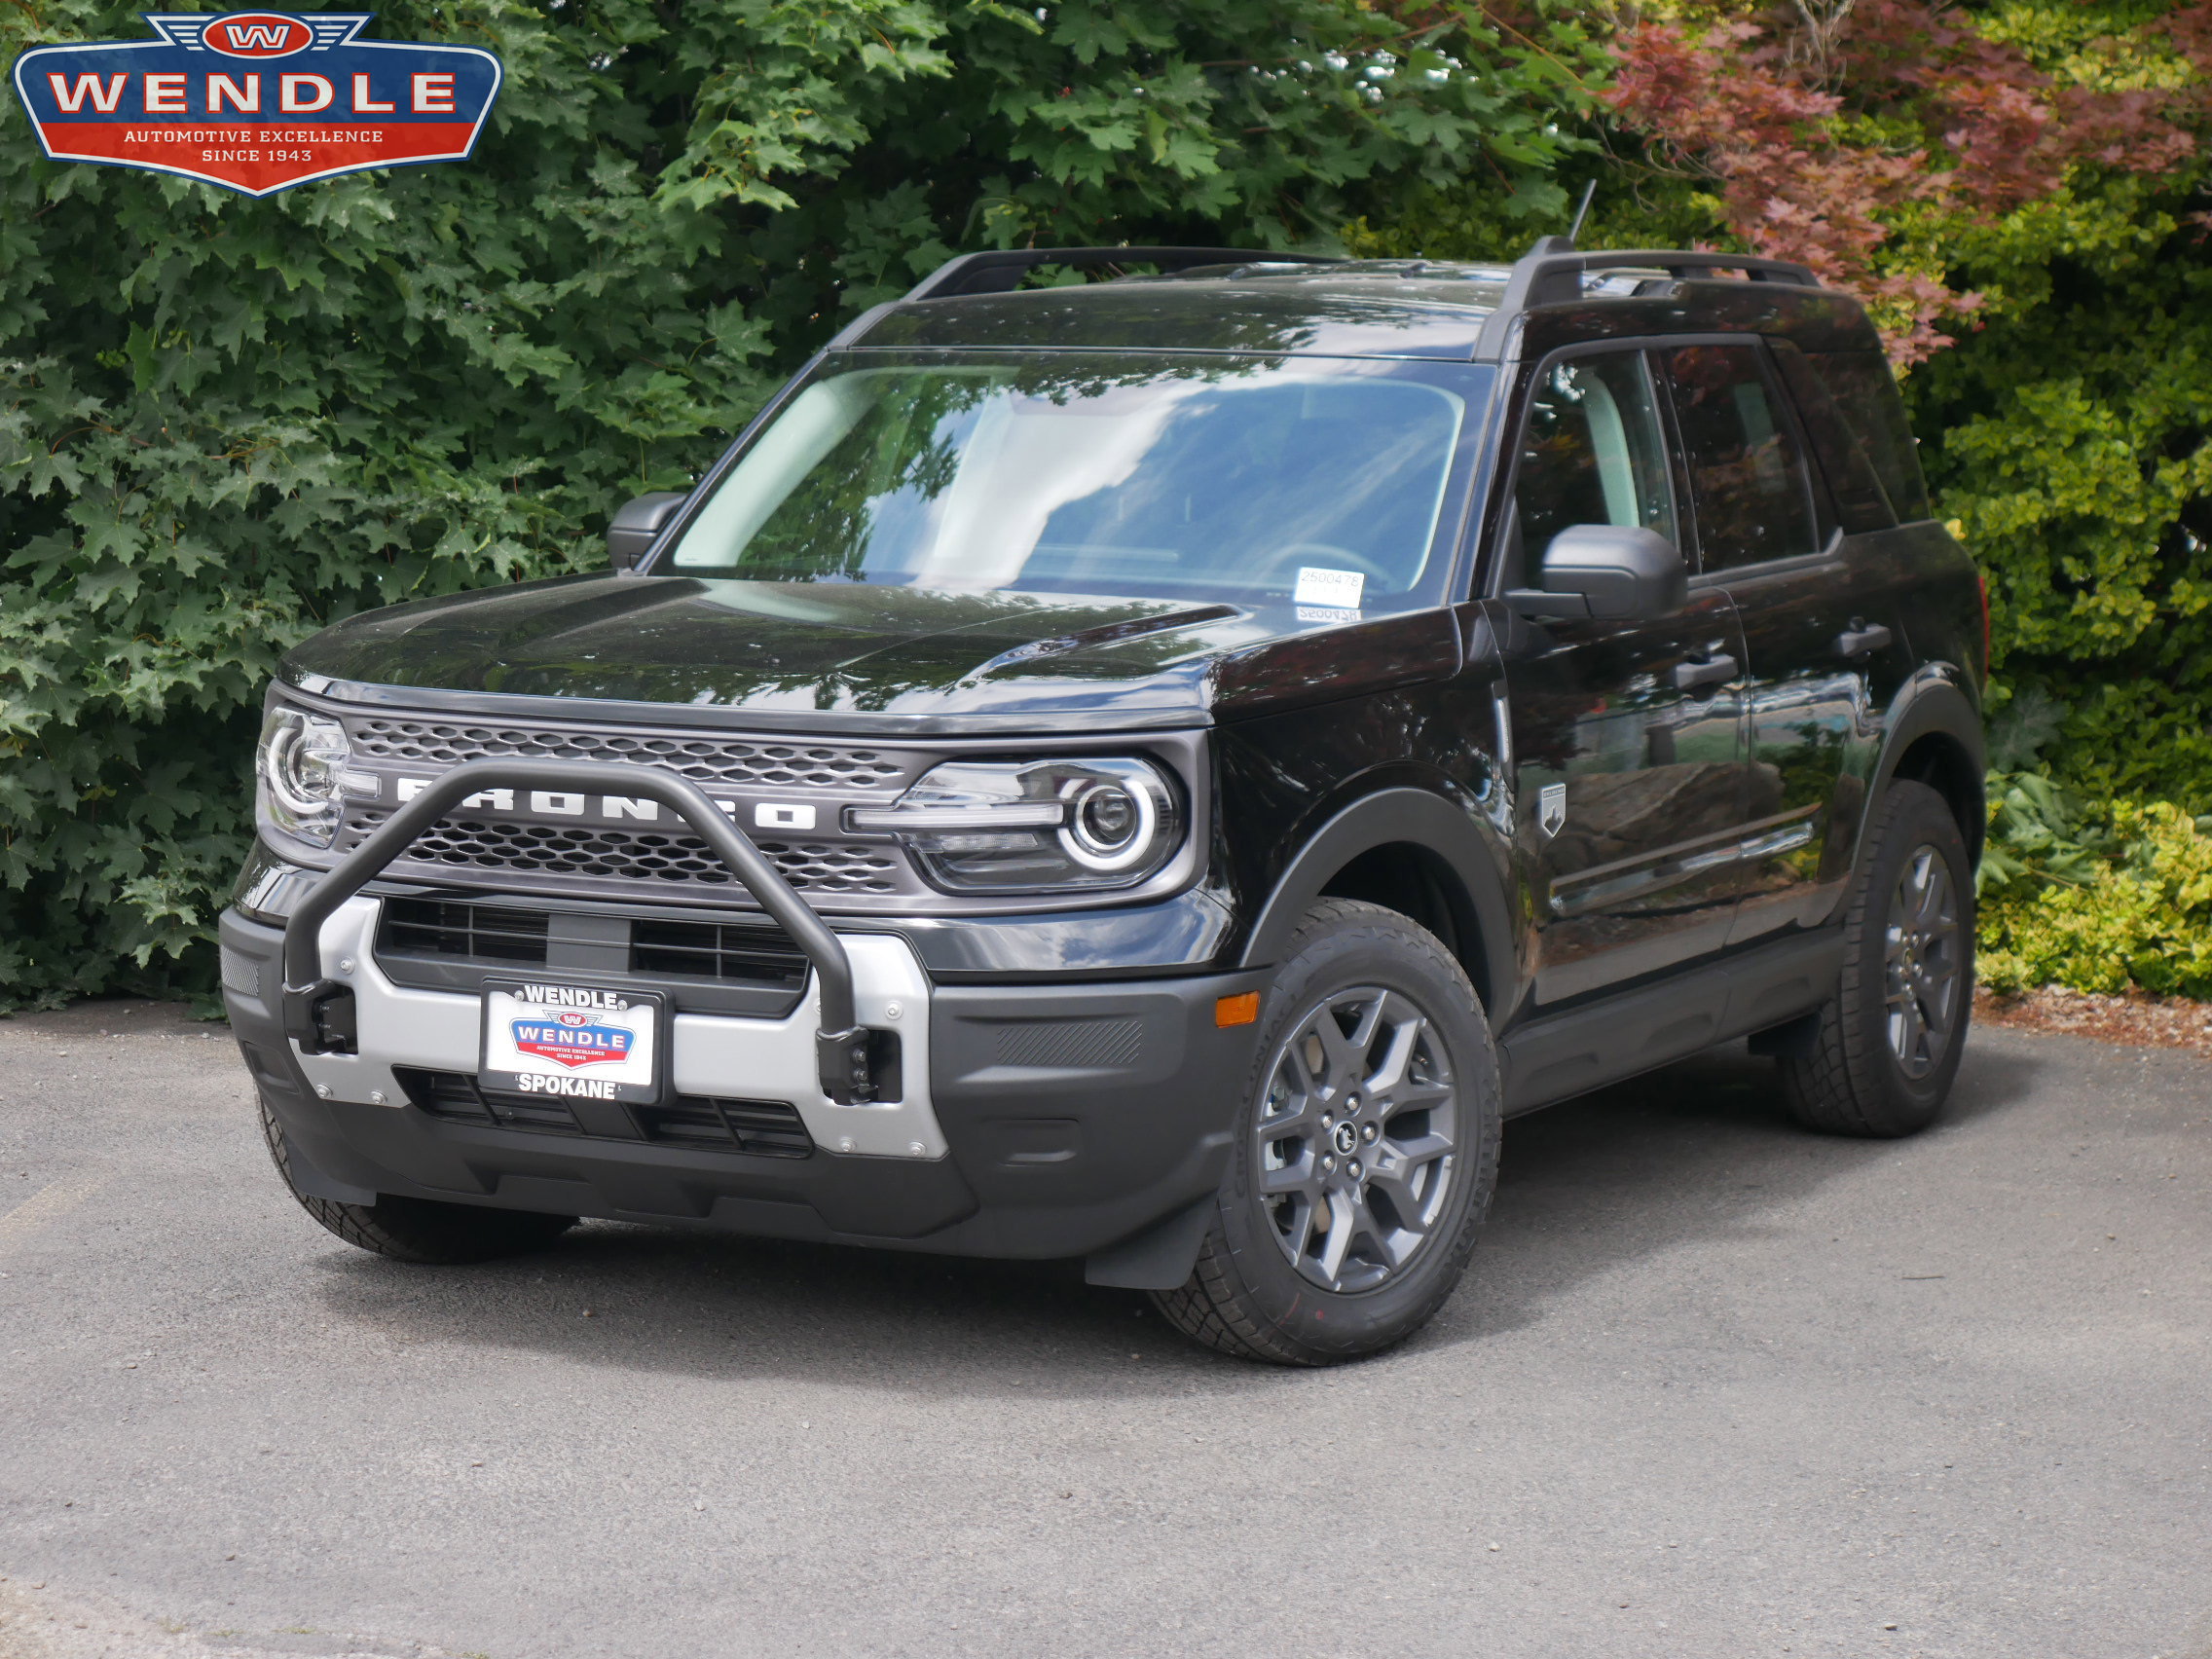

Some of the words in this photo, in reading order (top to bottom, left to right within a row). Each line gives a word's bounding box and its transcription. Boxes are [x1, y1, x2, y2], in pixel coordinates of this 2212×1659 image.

[524, 984, 617, 1010] WENDLE
[518, 1026, 625, 1049] WENDLE
[518, 1073, 616, 1100] SPOKANE
